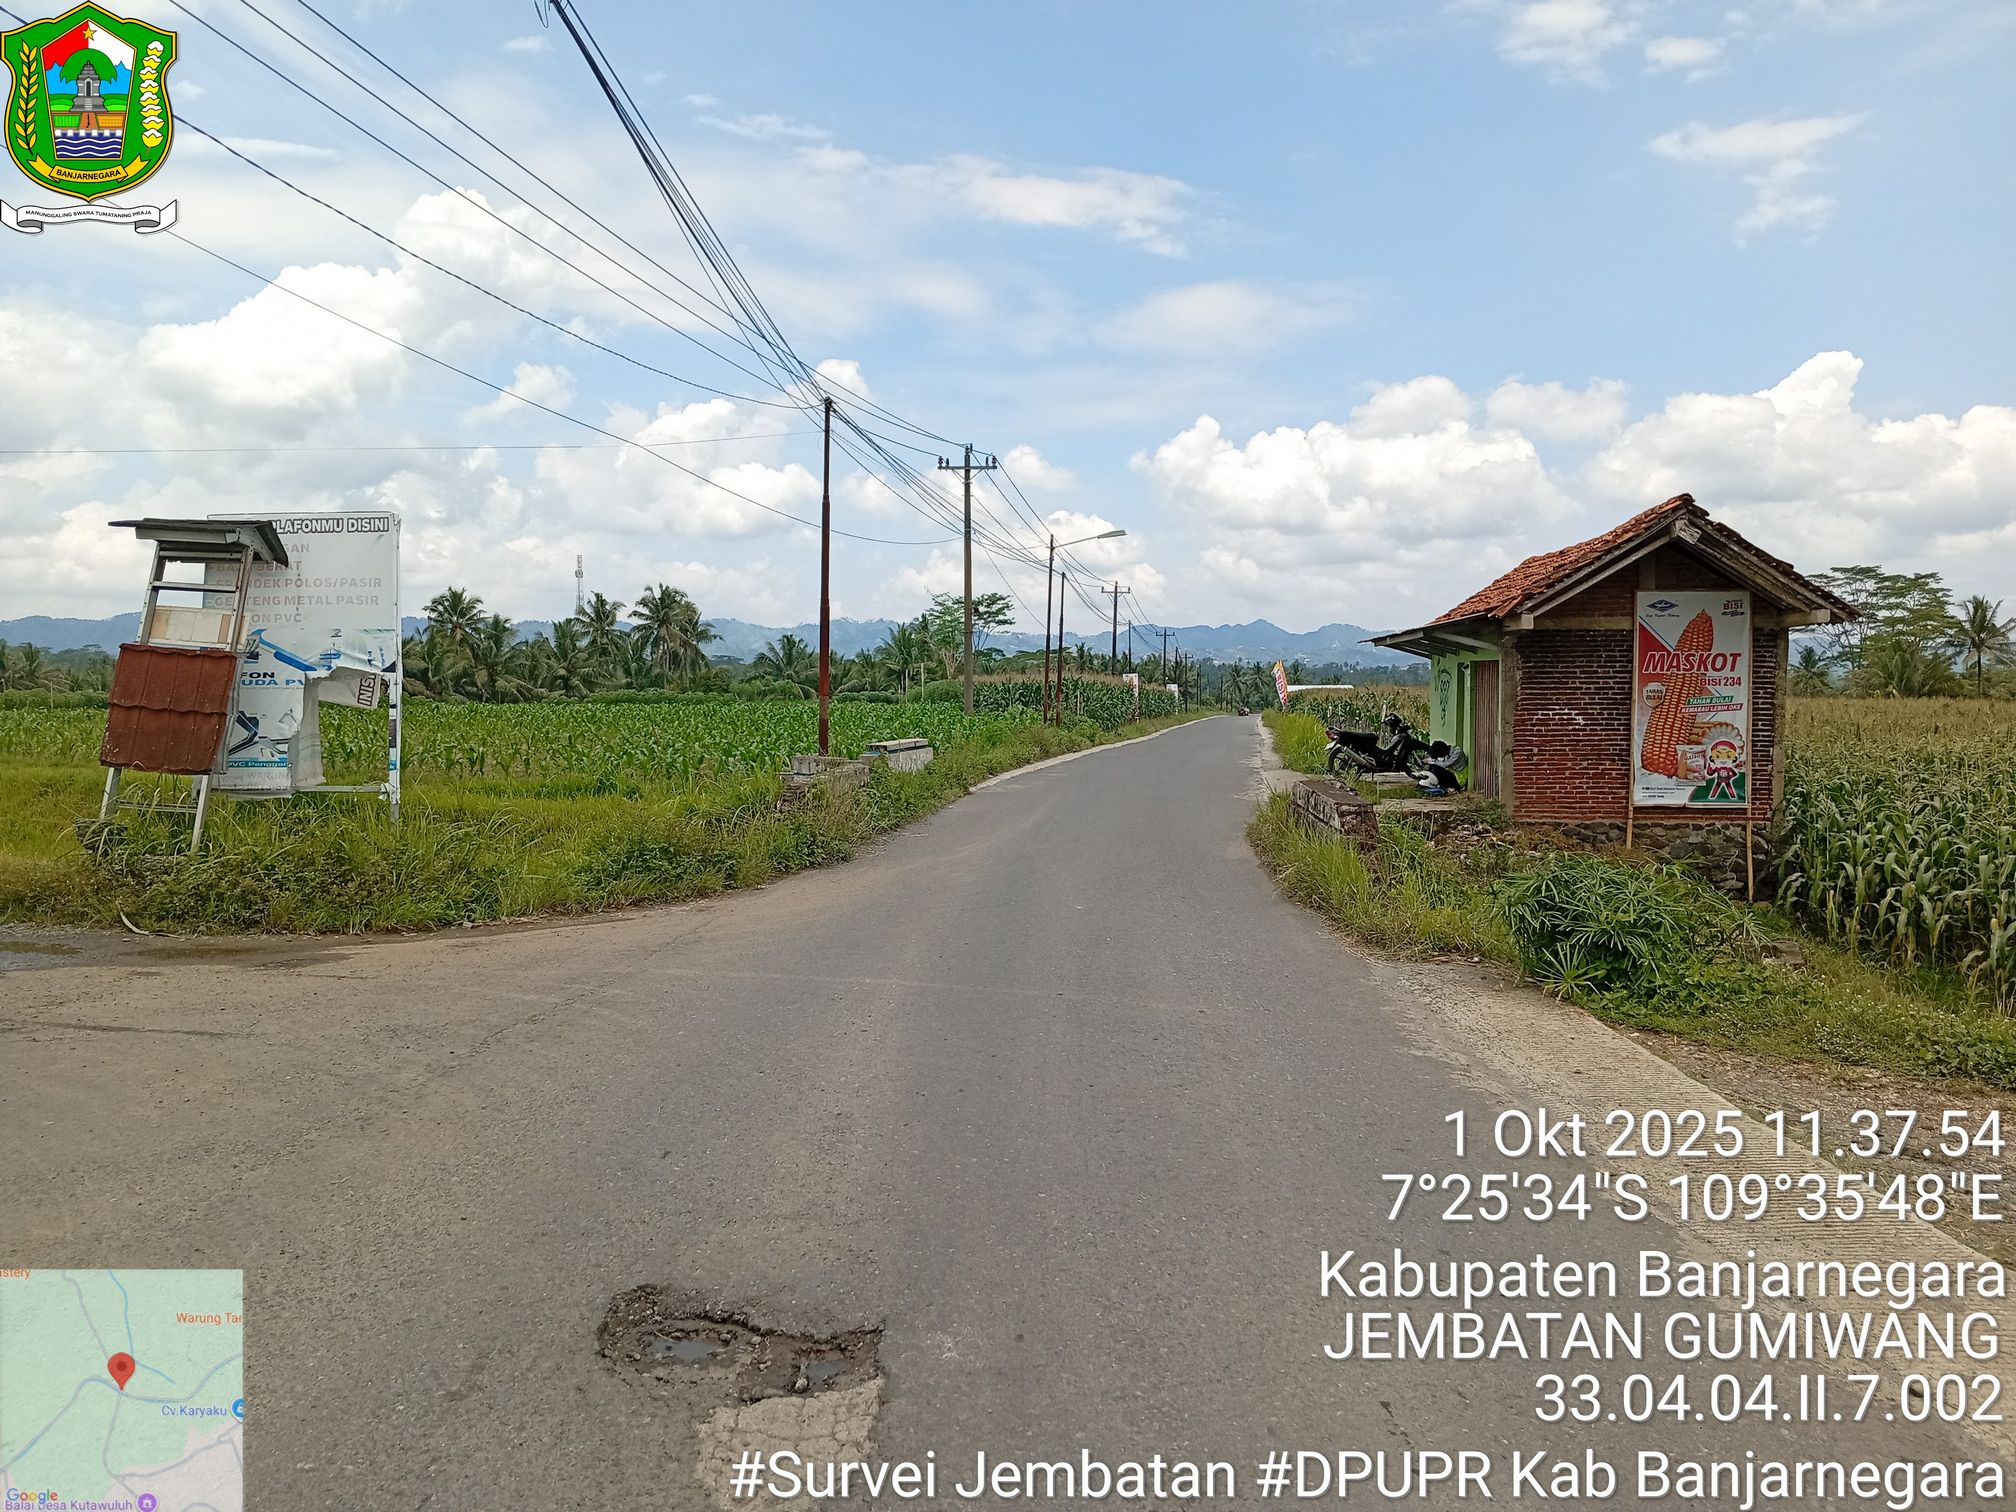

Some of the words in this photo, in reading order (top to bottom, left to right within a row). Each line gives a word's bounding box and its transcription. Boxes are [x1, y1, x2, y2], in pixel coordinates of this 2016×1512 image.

[347, 517, 389, 532] DISINI
[284, 577, 382, 588] POLOS/PASIR
[215, 596, 281, 606] GETENG
[285, 595, 333, 606] METAL
[336, 595, 380, 605] PASIR
[1723, 602, 1743, 610] BISI
[275, 613, 302, 624] PVC
[1642, 651, 1742, 674] MASKOT
[1699, 678, 1722, 687] BISI
[1723, 676, 1742, 687] 234
